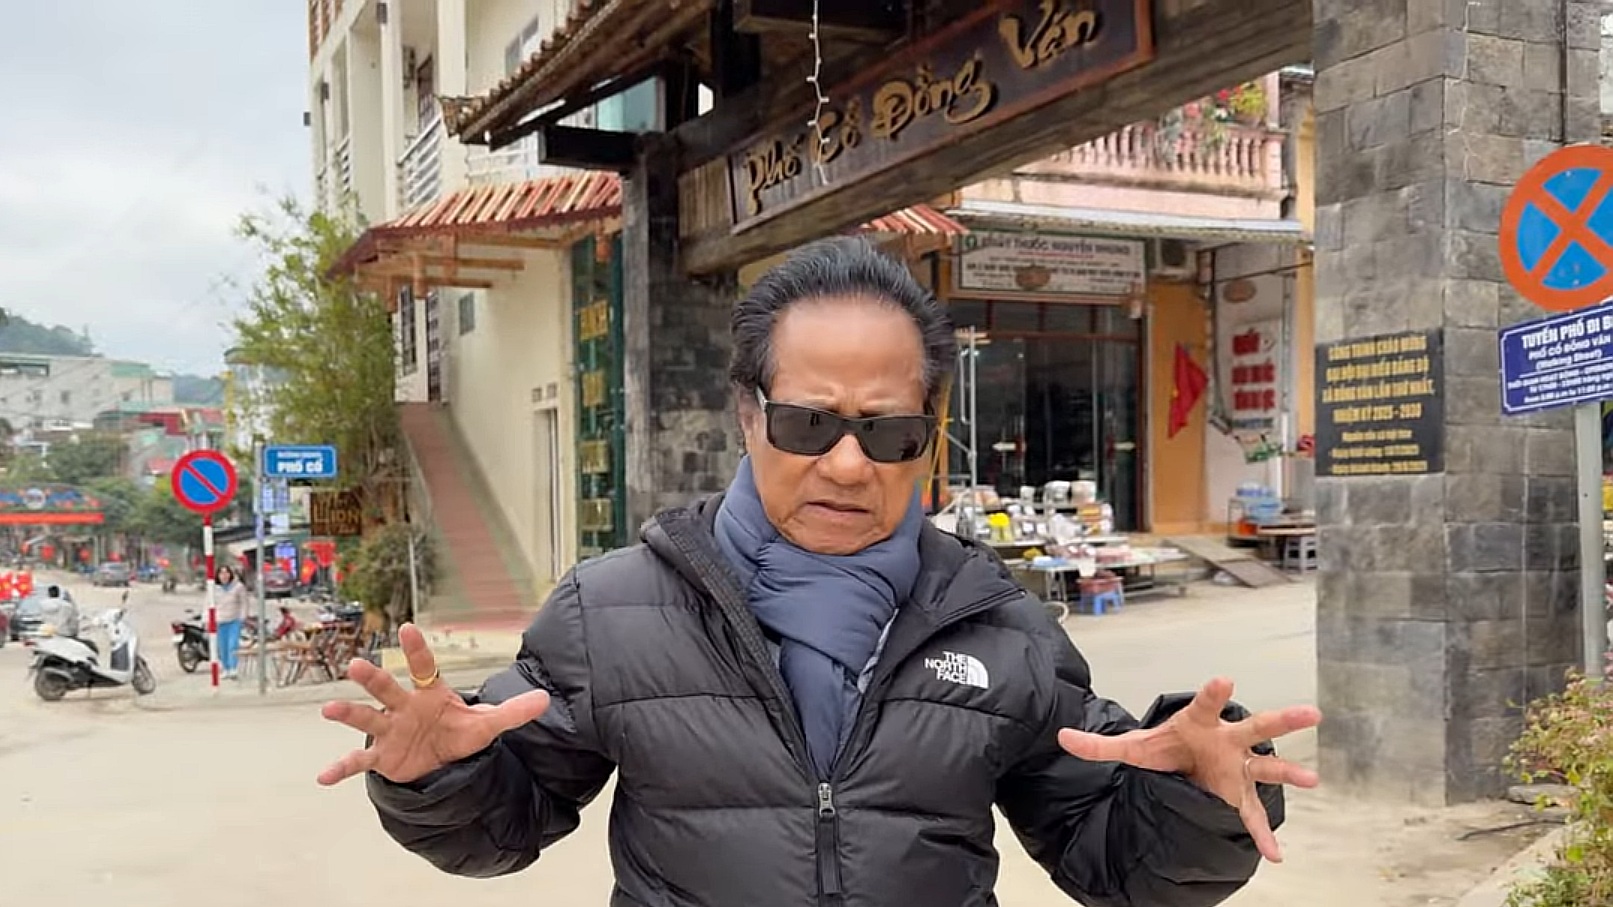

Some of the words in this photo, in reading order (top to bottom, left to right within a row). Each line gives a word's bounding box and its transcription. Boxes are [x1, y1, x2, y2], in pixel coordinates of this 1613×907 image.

[743, 131, 806, 215] Phố
[810, 95, 864, 165] Cổ
[870, 51, 998, 141] Đồng
[1000, 0, 1097, 70] Văn
[1521, 324, 1558, 350] TUYẾN
[1560, 317, 1584, 341] PHỐ
[1586, 318, 1600, 334] ĐI
[1602, 315, 1613, 331] B
[1528, 346, 1547, 361] PHỐ
[1548, 341, 1562, 357] CỔ
[1564, 339, 1590, 354] ĐỒNG
[1592, 333, 1611, 346] VĂN
[277, 458, 303, 474] PHỐ
[305, 457, 323, 474] CỔ
[924, 657, 968, 672] NORTH
[943, 651, 968, 662] THE
[936, 668, 968, 685] FACE
